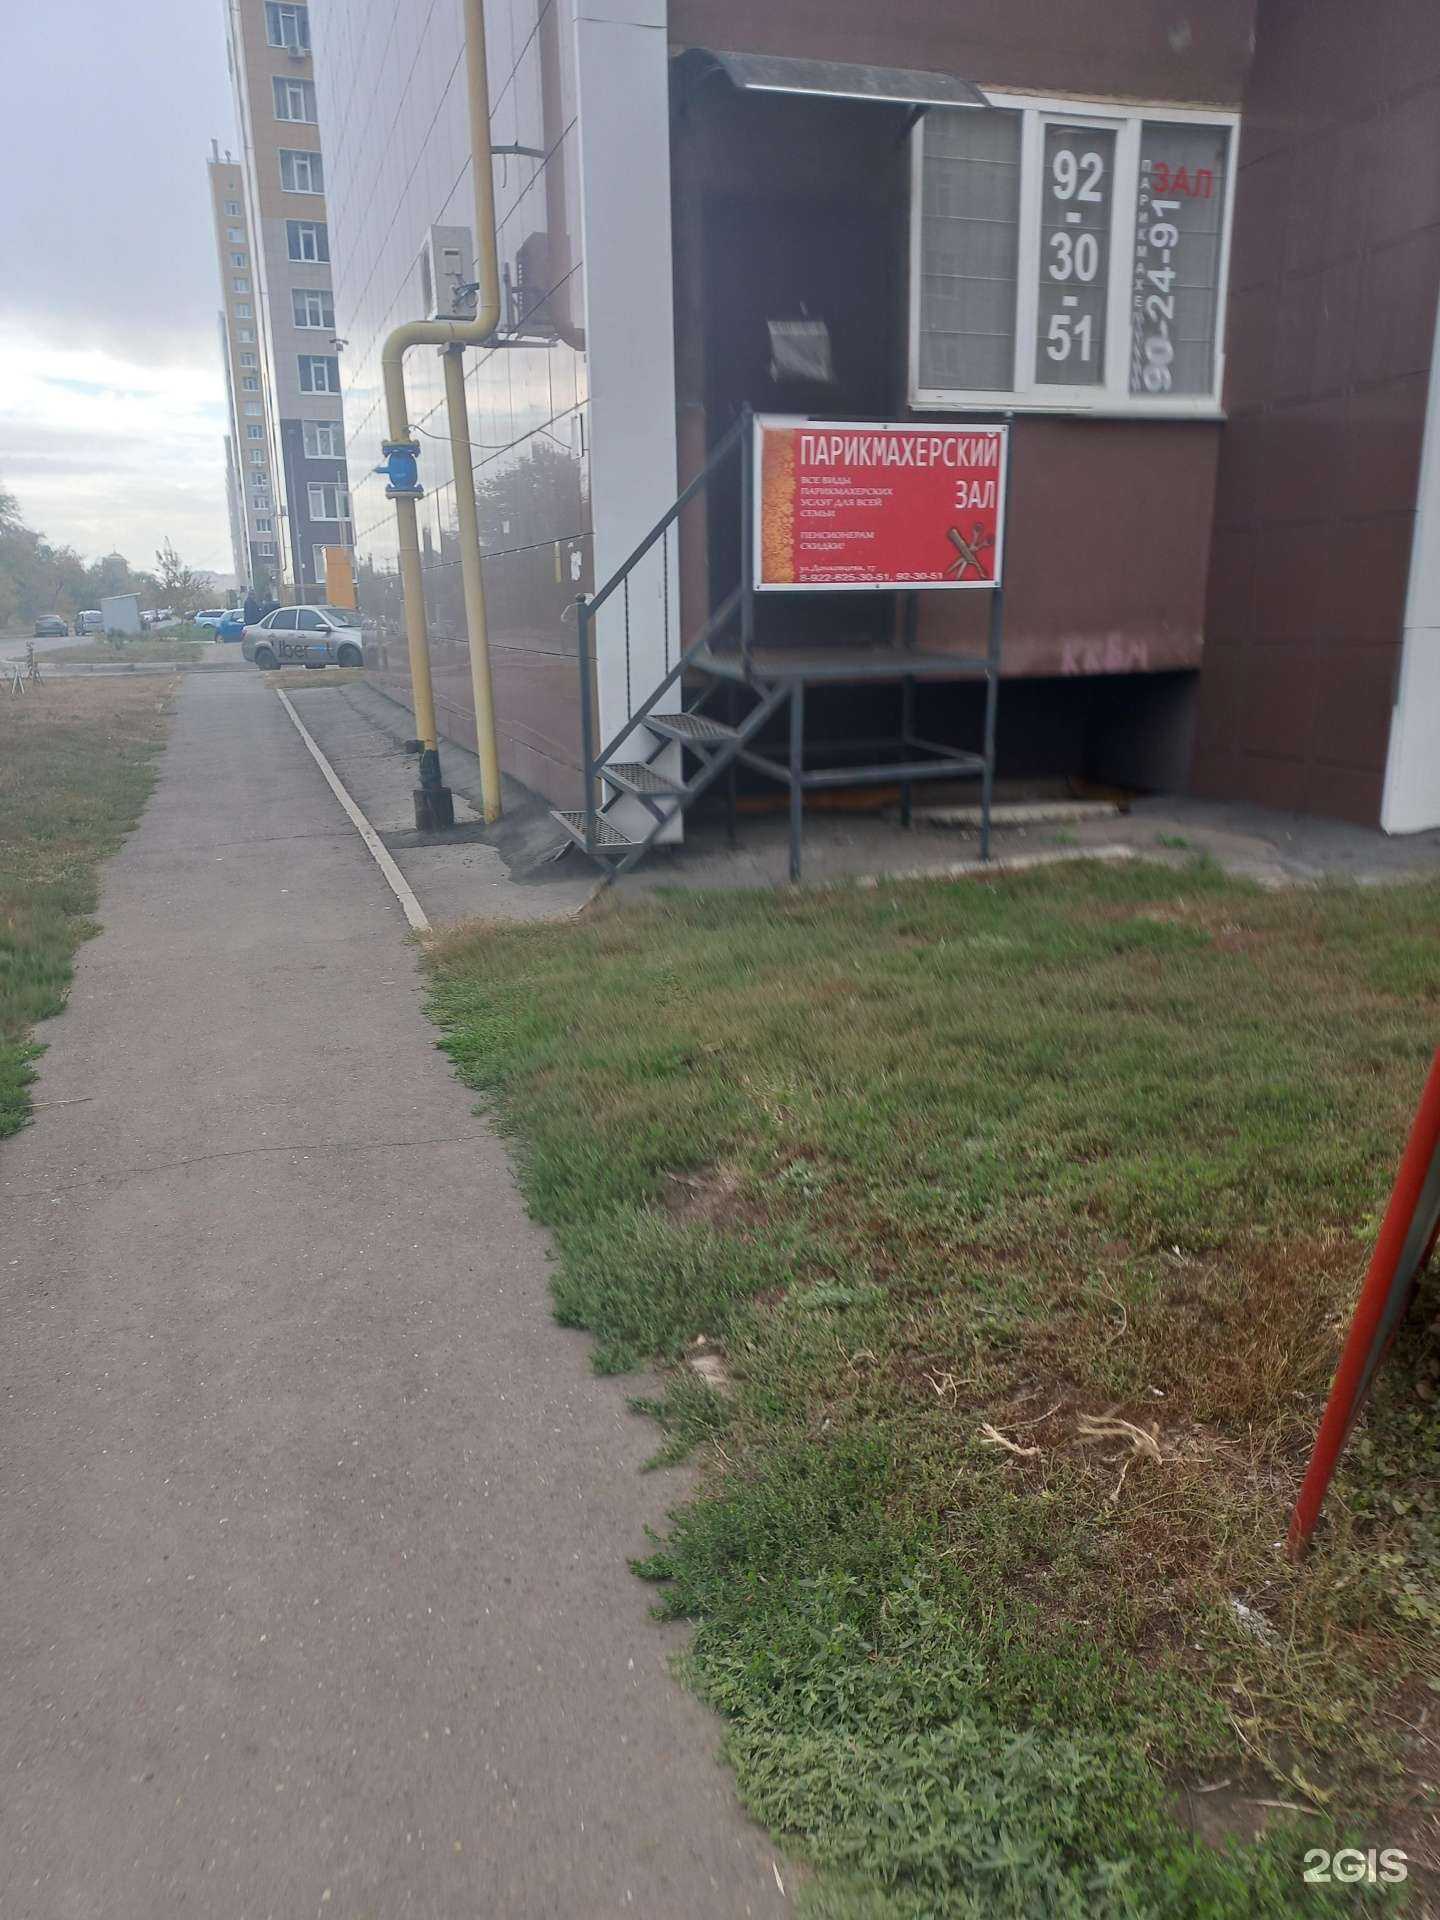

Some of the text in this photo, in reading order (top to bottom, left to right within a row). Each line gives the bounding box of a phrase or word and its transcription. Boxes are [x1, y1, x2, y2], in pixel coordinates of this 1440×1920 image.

[1152, 161, 1214, 199] ЗАЛ
[1143, 199, 1182, 393] 90-24-91
[800, 432, 998, 467] ПАРИКМАХЕРСКИЙ
[800, 476, 852, 485] ВСЕ ВИДЫ
[800, 487, 893, 496] ПАРИКМАХЕРСКИХ
[954, 480, 995, 509] ЗАЛ
[800, 498, 883, 508] УСЛУГ ДЛЯ ВСЕЙ
[800, 509, 836, 517] СЕМЬИ
[800, 531, 875, 539] ПЕНСИОНЕРАМ
[895, 571, 943, 581] 92-30-51
